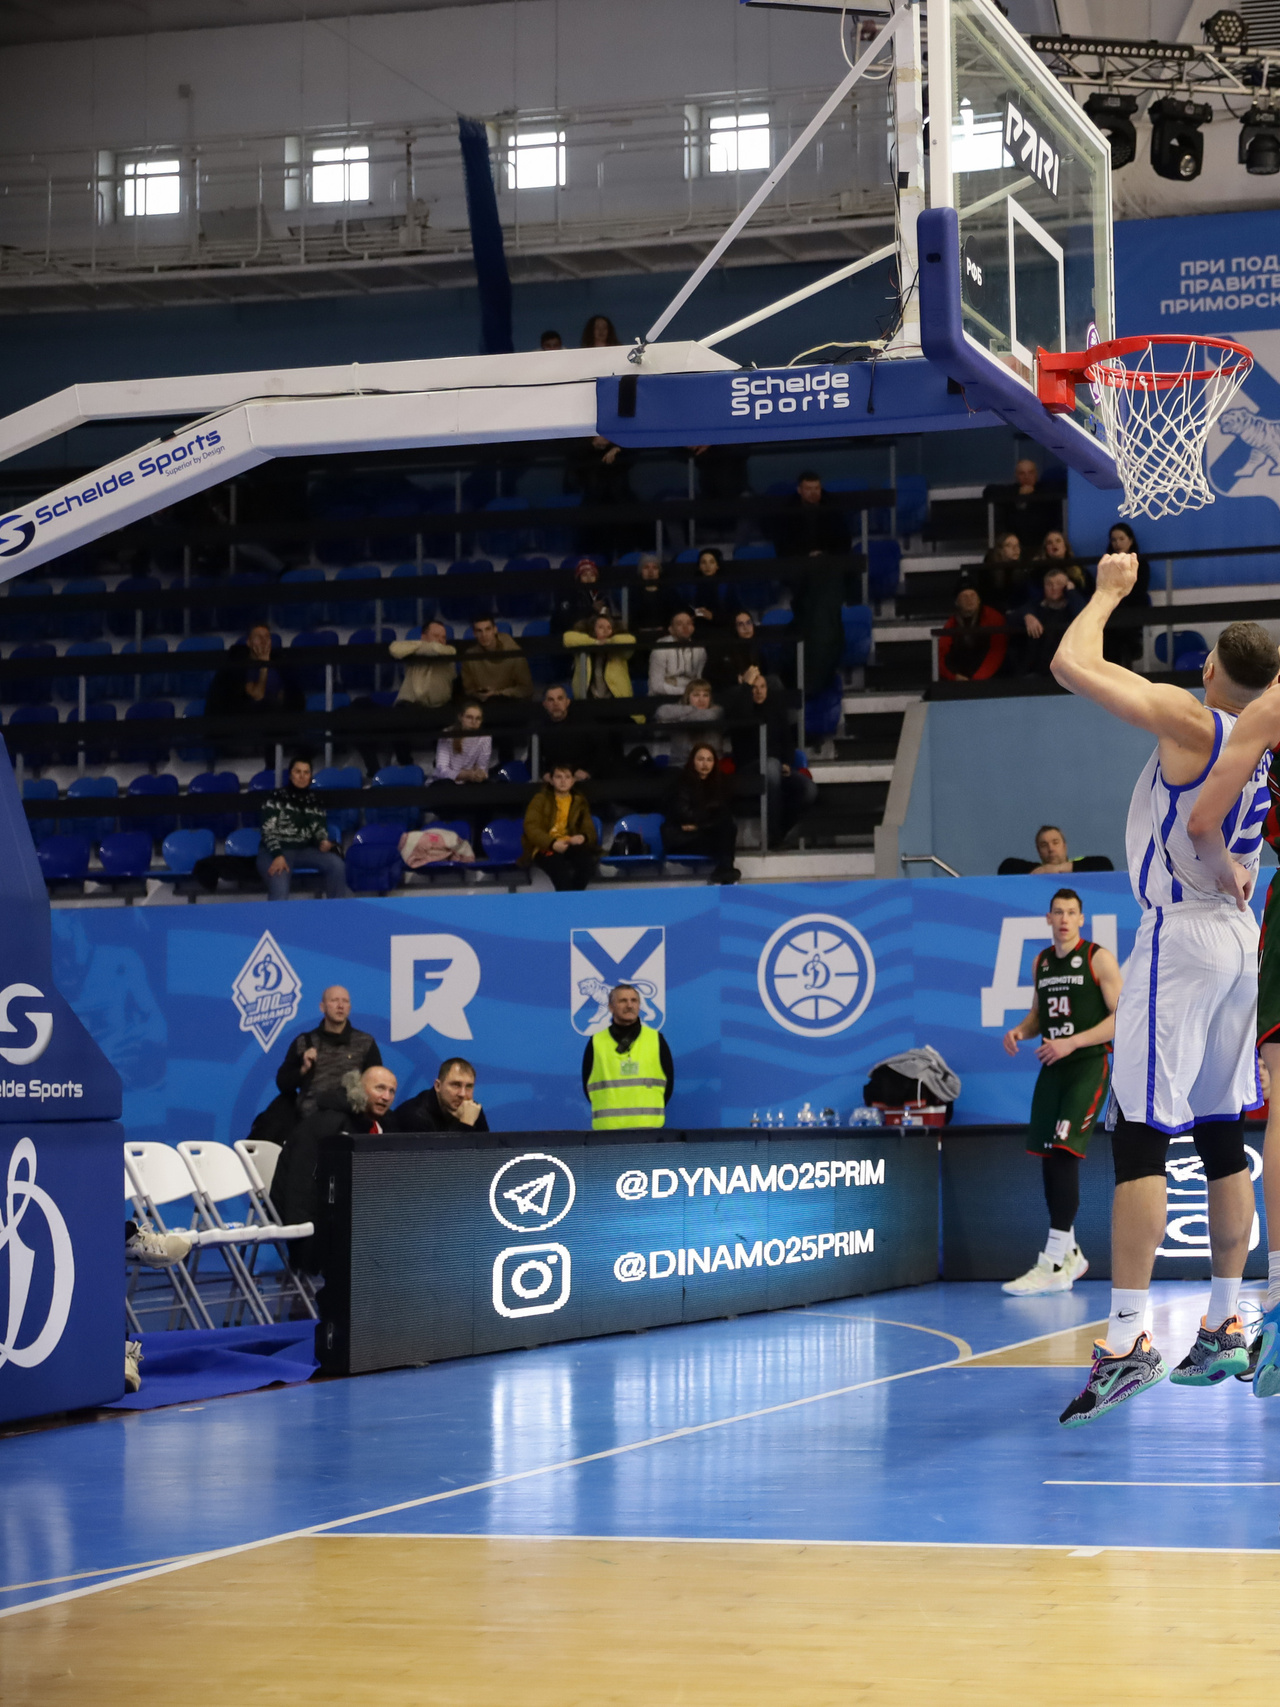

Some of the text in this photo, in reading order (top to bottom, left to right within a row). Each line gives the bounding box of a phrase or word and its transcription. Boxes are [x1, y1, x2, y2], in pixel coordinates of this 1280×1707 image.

[1005, 101, 1060, 196] PARI
[966, 257, 983, 286] РФБ
[1180, 259, 1225, 277] ПРИ
[731, 371, 850, 397] Schelde
[731, 391, 850, 420] Sports
[165, 445, 226, 477] Superior by Design
[35, 430, 222, 525] Schelde Sports
[1047, 996, 1071, 1018] 24
[29, 1079, 84, 1103] Sports
[616, 1158, 885, 1201] @DYNAMO25PRIM
[613, 1228, 875, 1283] @DINAMO25PRIM
